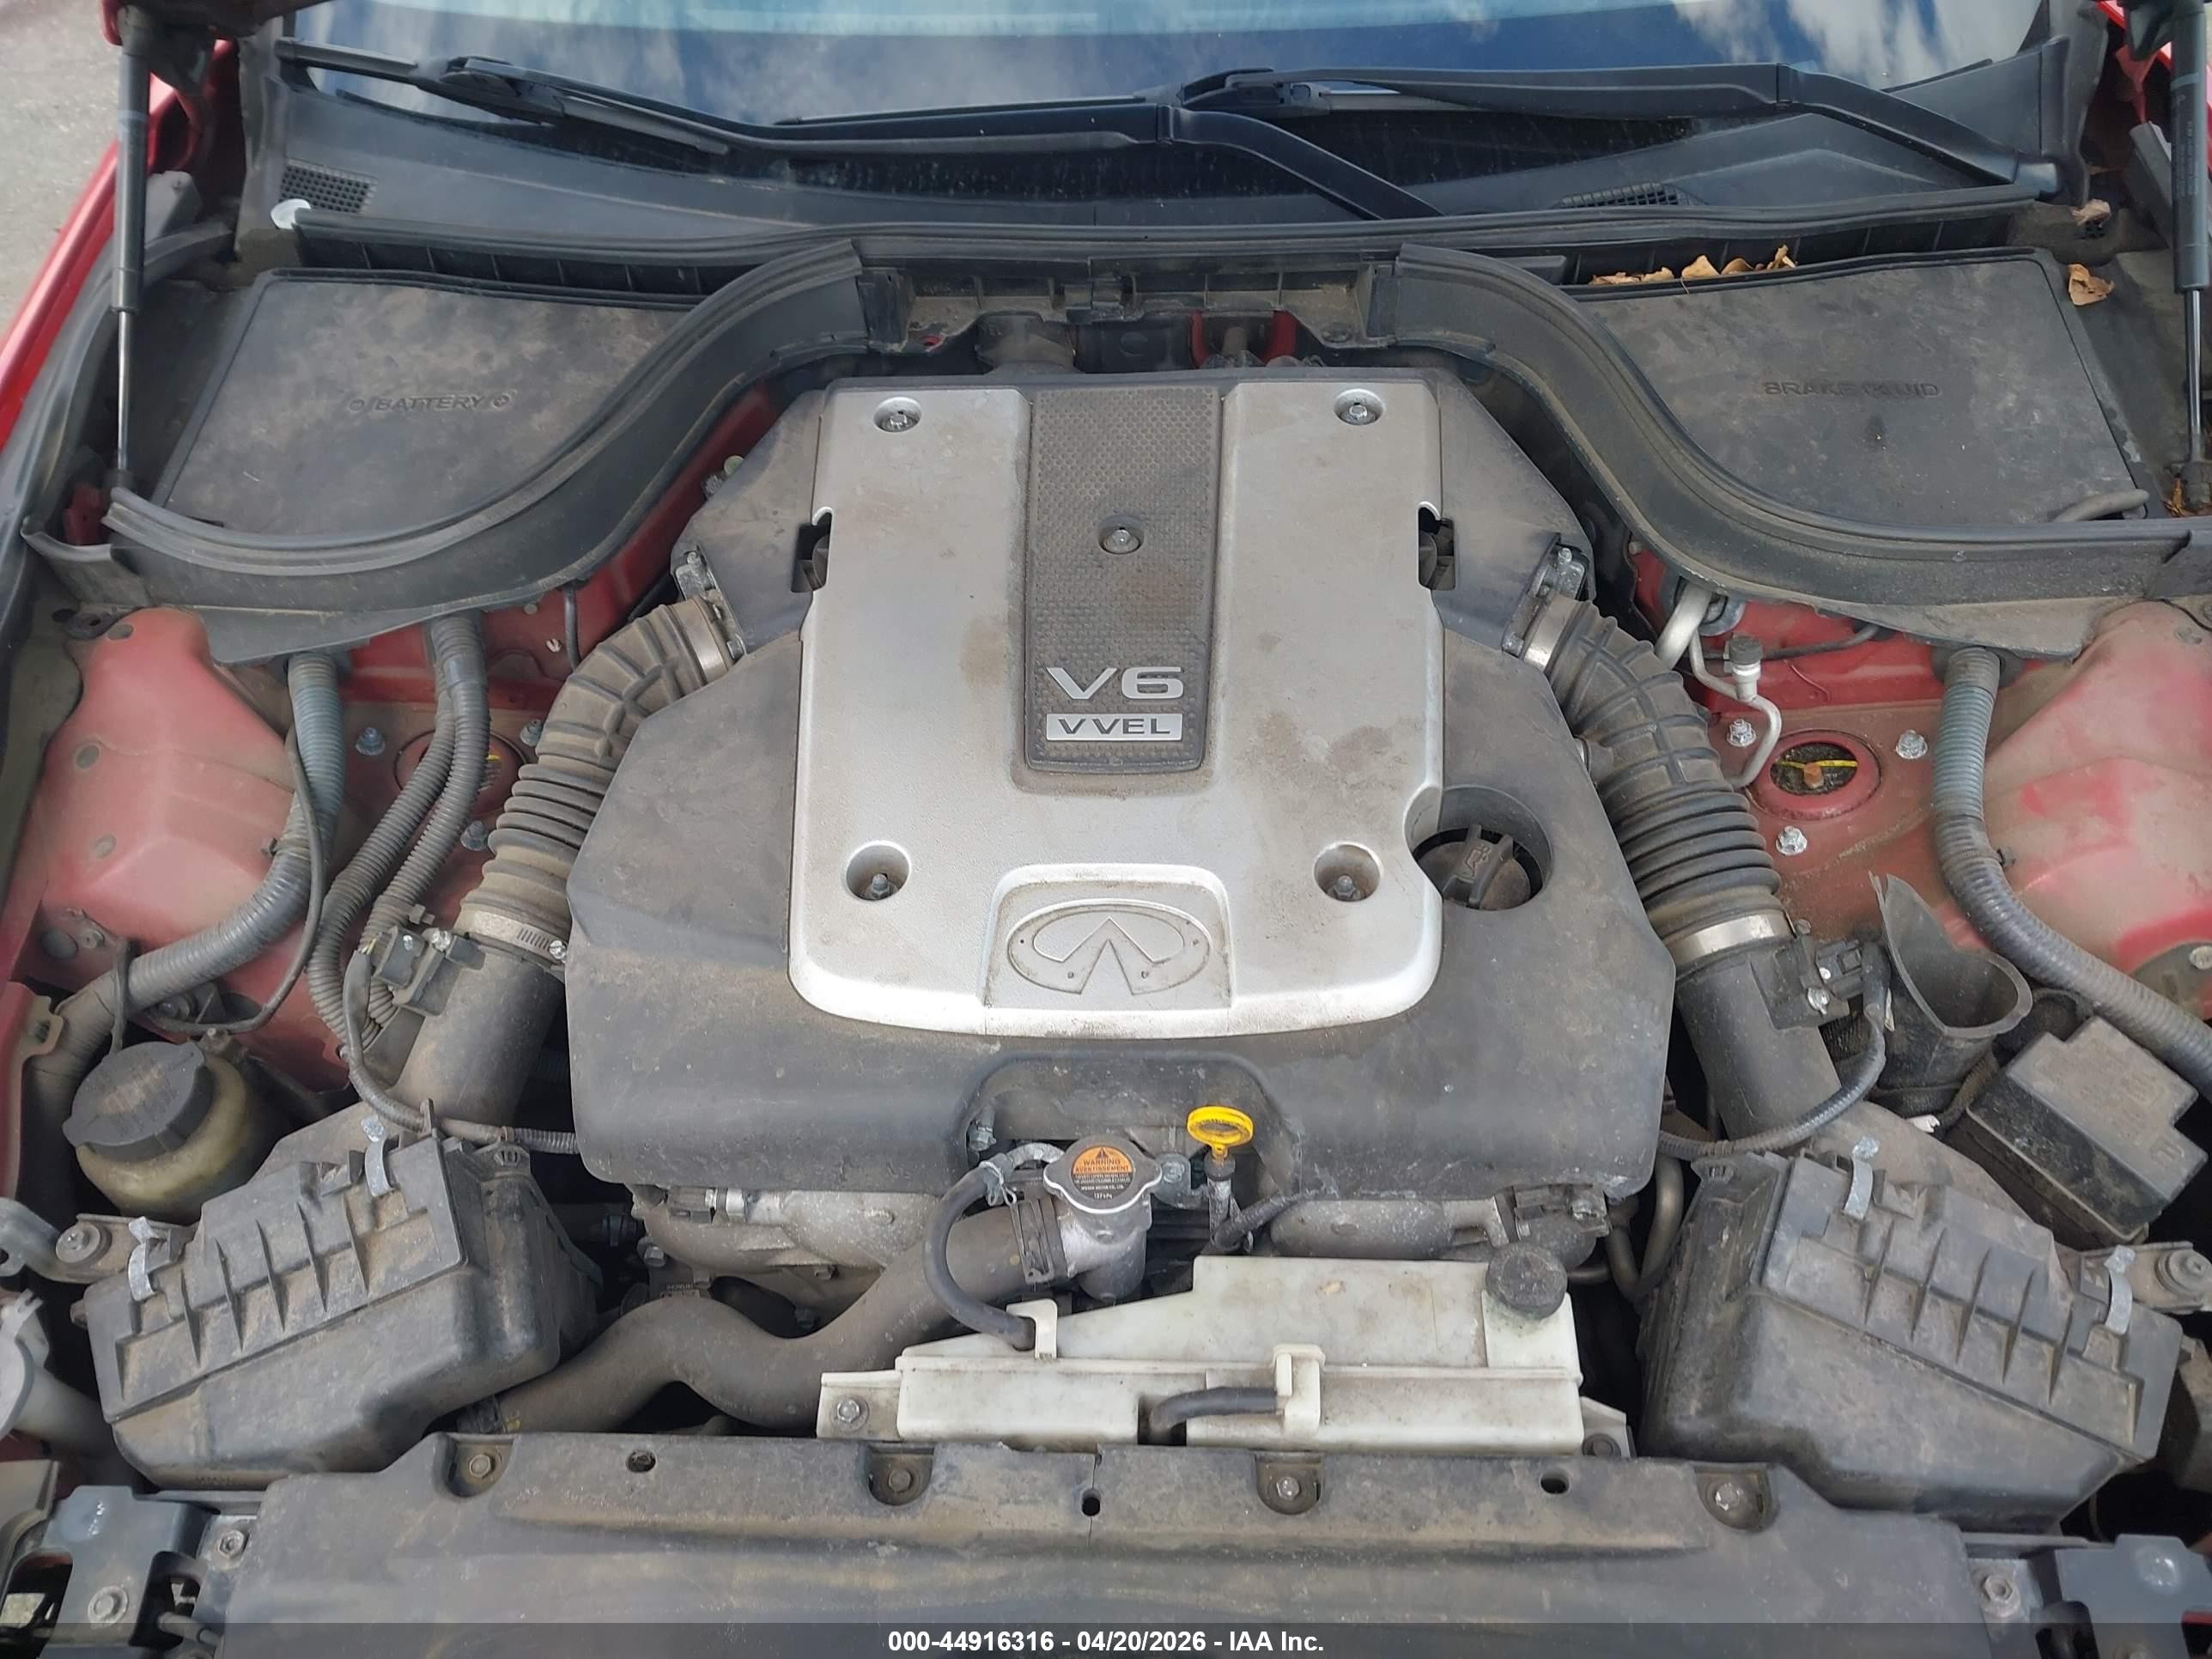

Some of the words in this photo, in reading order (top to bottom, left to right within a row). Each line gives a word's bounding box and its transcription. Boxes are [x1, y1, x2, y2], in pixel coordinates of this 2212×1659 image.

[374, 396, 483, 411] BATTERY
[1045, 666, 1184, 700] V6
[1058, 718, 1171, 735] VVEL
